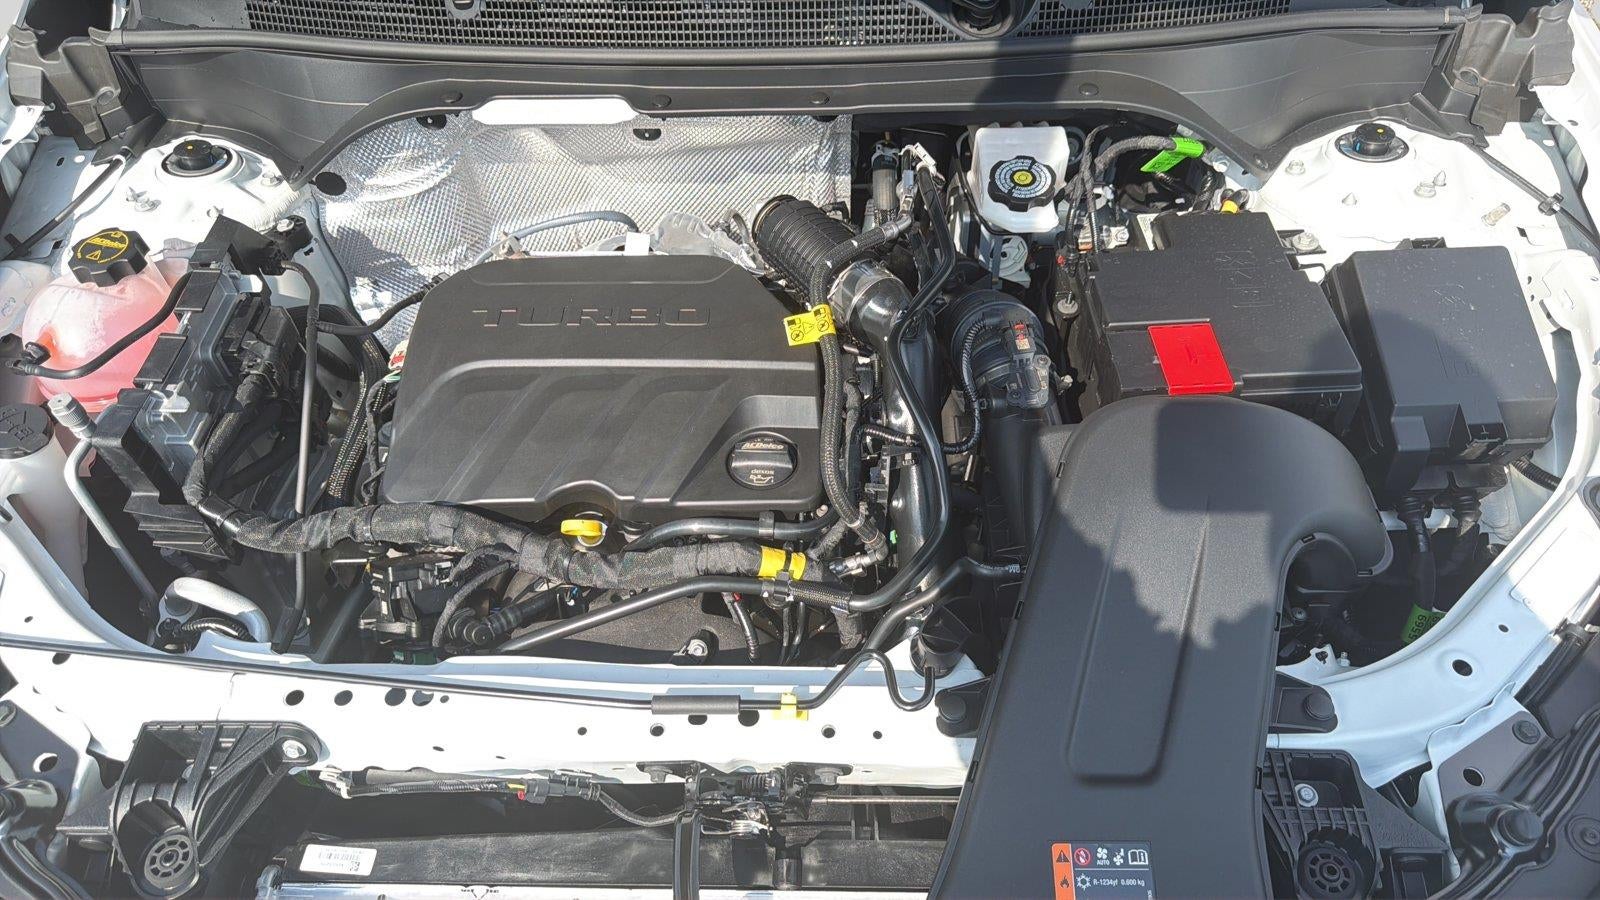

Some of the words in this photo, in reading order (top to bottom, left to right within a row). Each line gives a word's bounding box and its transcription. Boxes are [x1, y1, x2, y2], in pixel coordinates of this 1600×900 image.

[472, 307, 711, 327] TURBO
[741, 442, 784, 450] ACDelco
[1408, 614, 1427, 640] 5569
[1093, 878, 1118, 887] R-1234yf
[1137, 878, 1145, 887] kg
